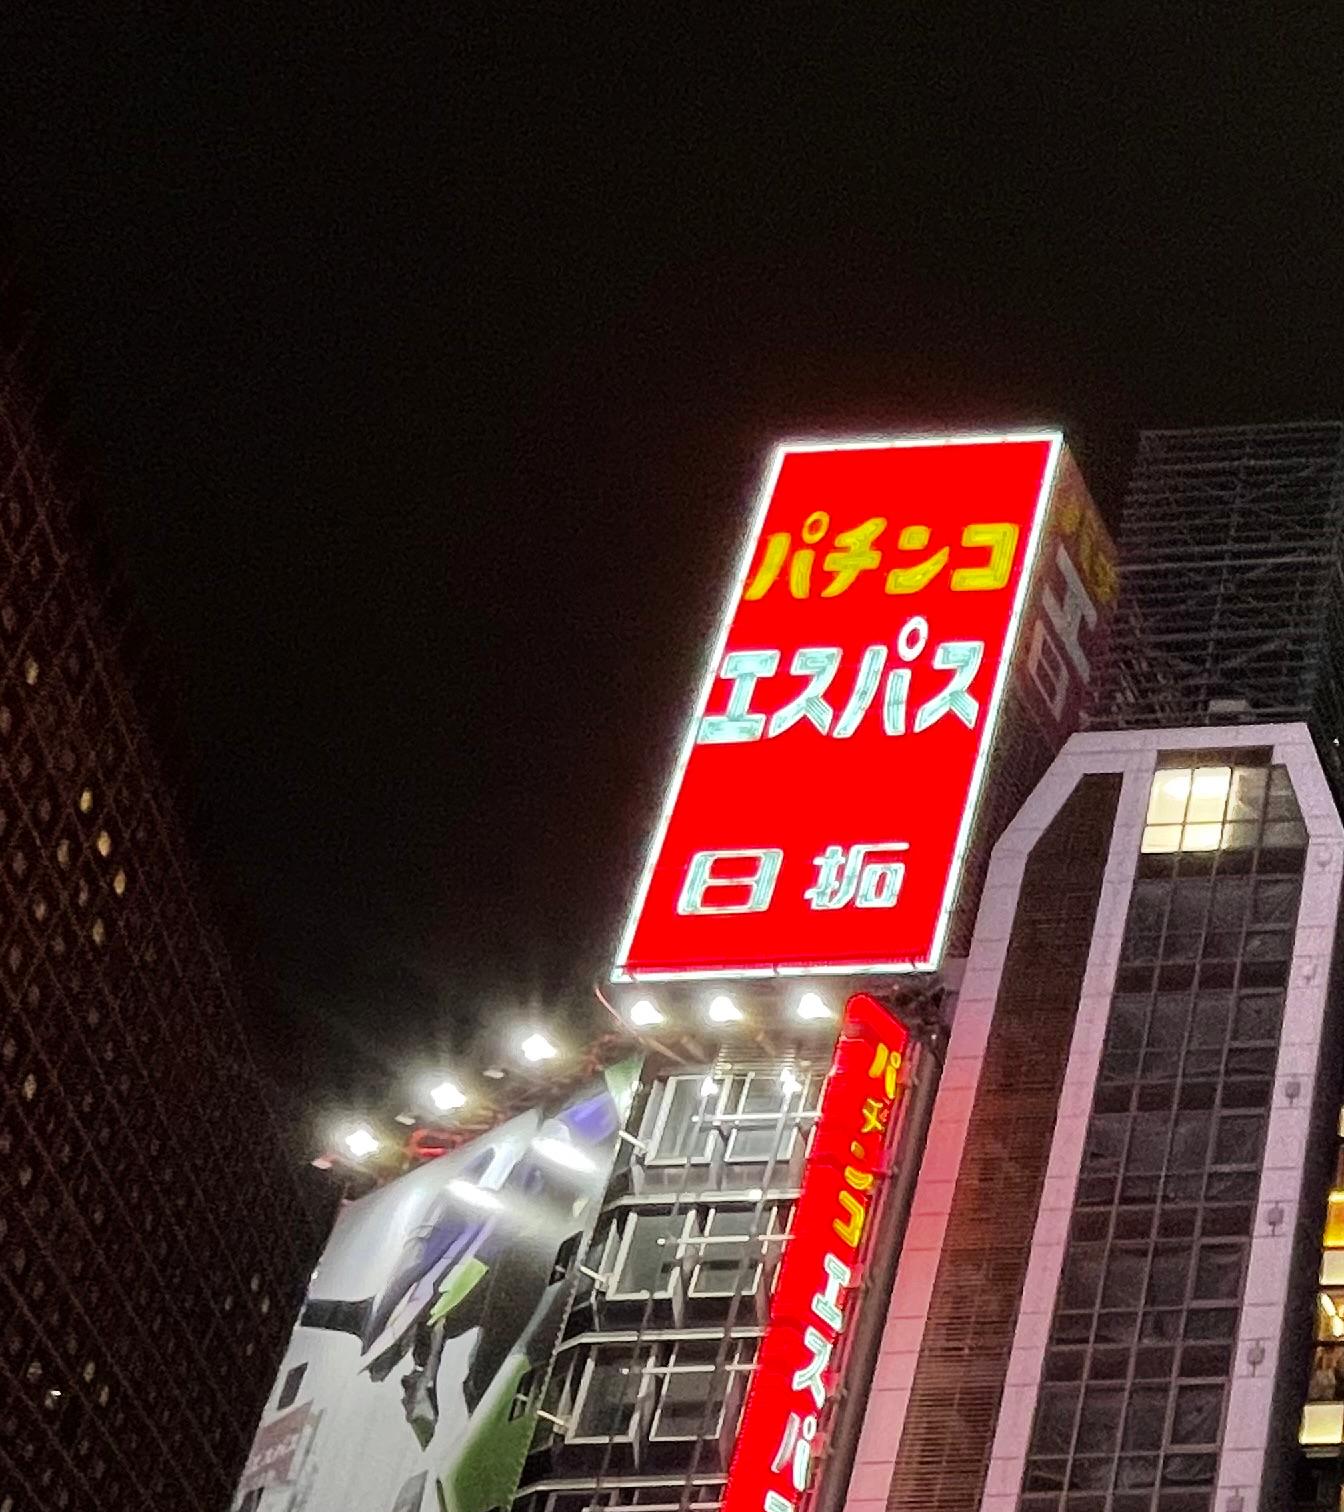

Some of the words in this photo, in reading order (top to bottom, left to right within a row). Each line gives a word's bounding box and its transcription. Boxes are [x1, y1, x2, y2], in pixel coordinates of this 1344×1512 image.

[741, 510, 1019, 601] パチンコ
[696, 617, 984, 744] エスパス
[677, 842, 909, 916] 日拓
